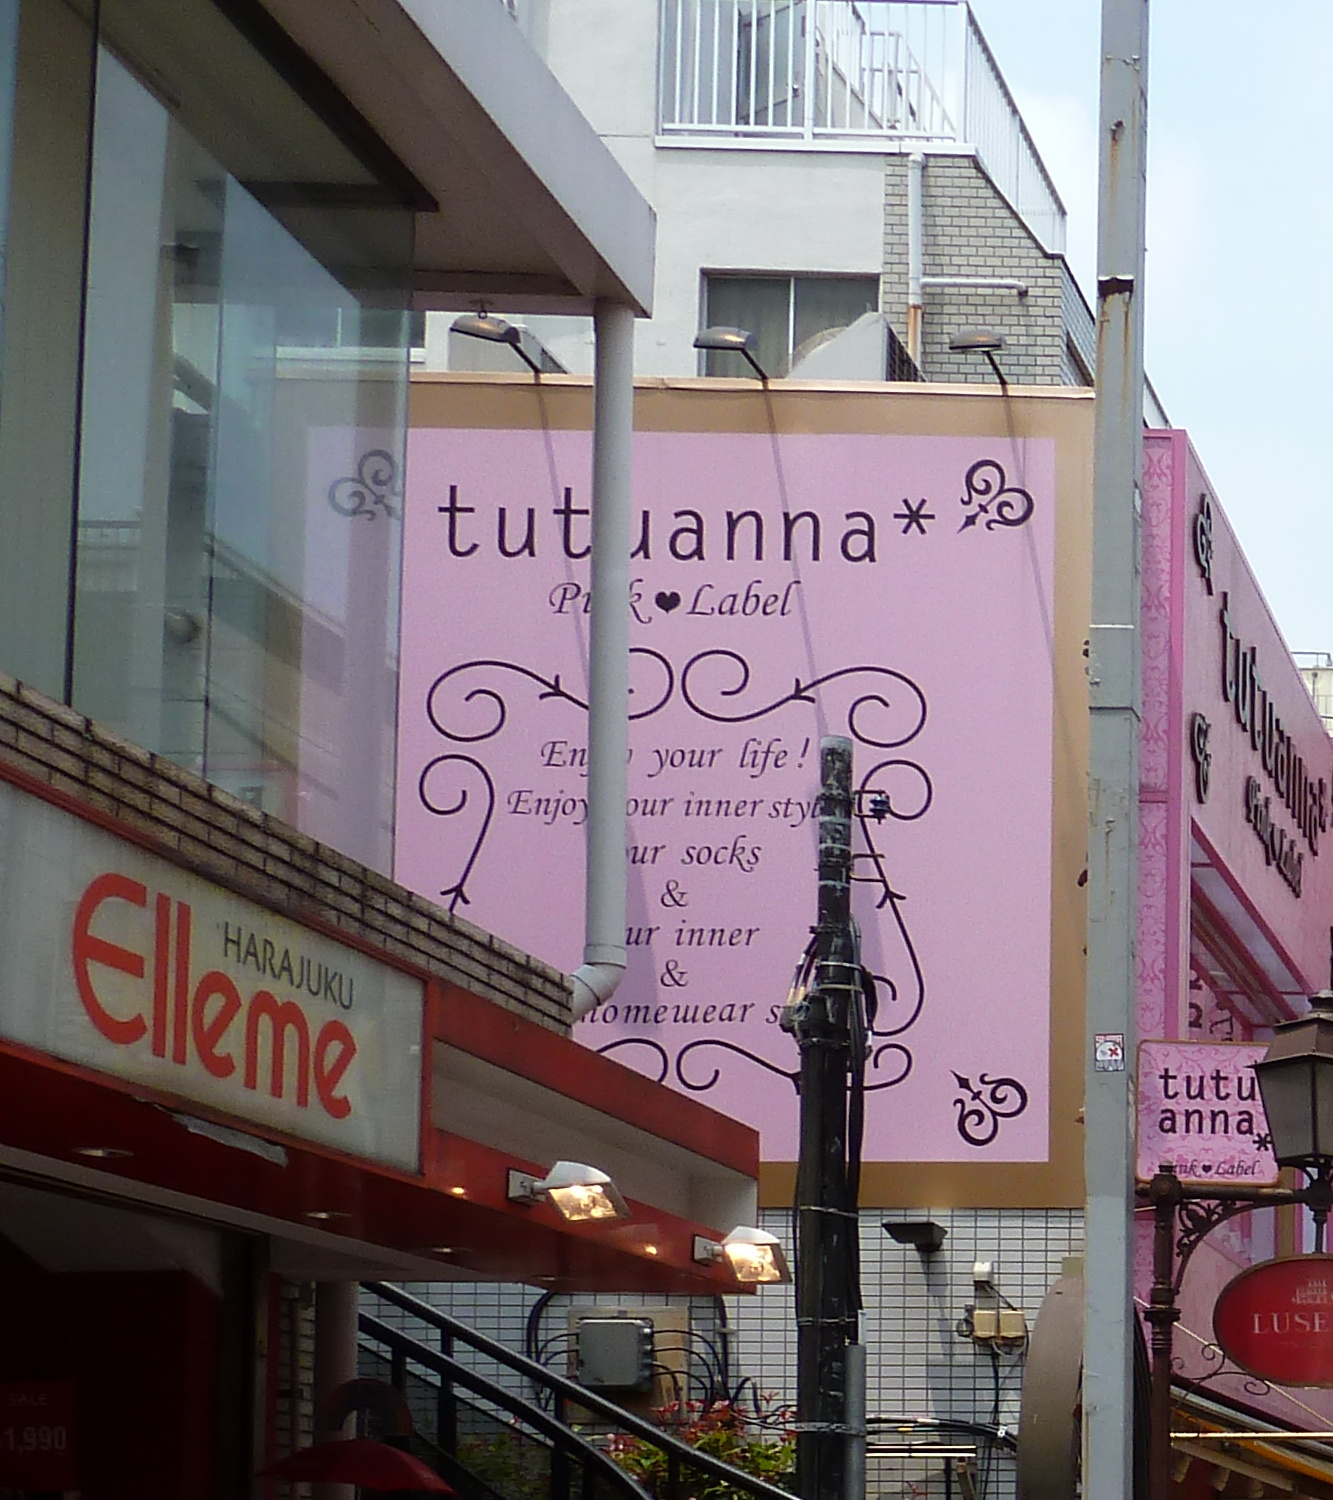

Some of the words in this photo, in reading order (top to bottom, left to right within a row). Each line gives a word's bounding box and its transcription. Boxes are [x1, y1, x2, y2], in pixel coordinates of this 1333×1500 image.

[687, 580, 802, 617] Label
[647, 747, 724, 777] your
[626, 797, 674, 818] our
[684, 791, 763, 819] inner
[681, 835, 762, 873] socks
[660, 880, 689, 908] &
[675, 919, 761, 947] inner
[222, 921, 355, 1010] HARAJUKU
[660, 960, 689, 988] &
[72, 872, 358, 1119] Elleme
[1159, 1068, 1255, 1101] tutu
